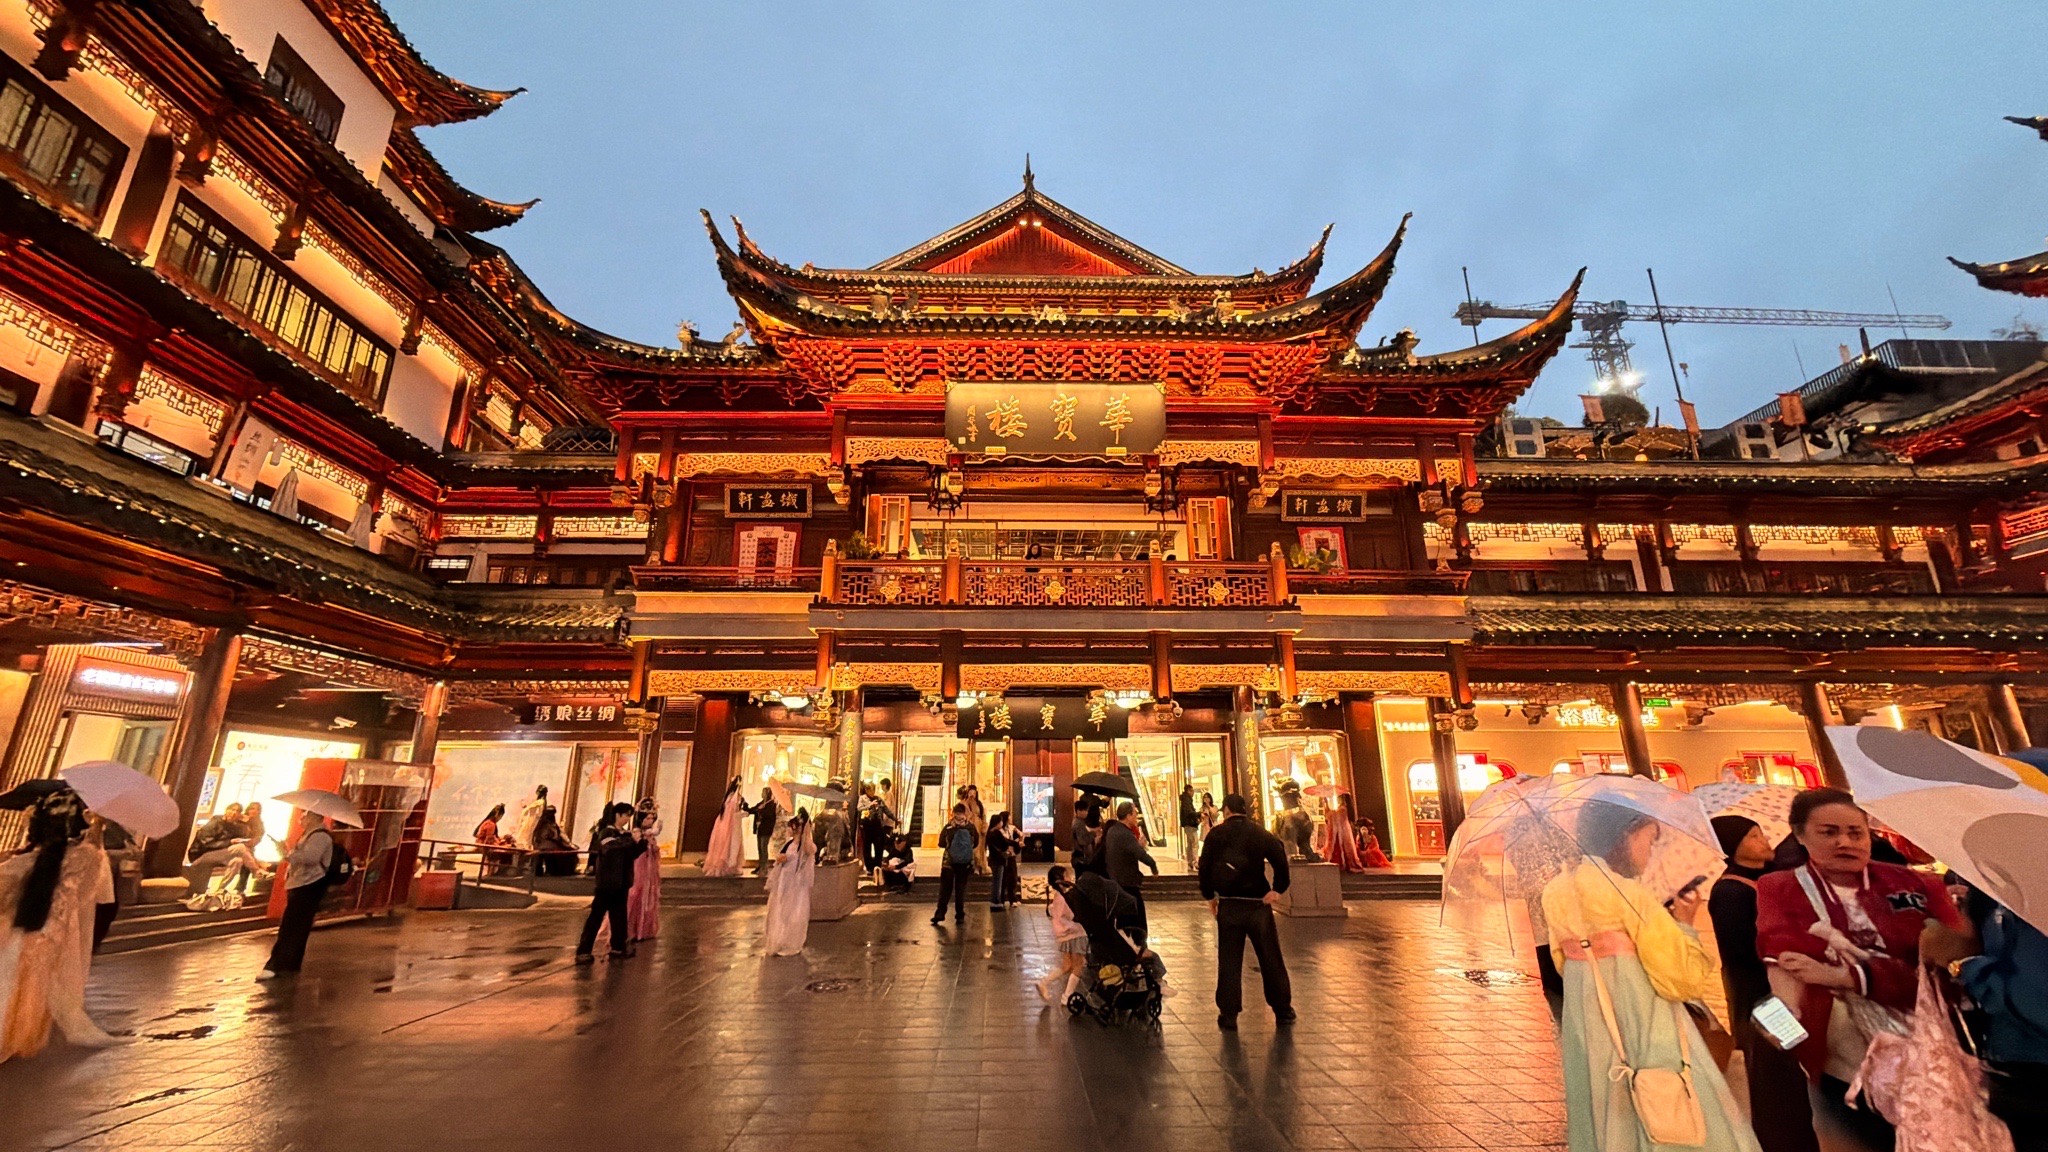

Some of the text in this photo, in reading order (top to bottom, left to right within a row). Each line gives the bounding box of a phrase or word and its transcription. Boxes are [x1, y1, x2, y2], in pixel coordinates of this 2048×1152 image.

[985, 393, 1133, 444] 華寶樓
[534, 705, 616, 721] 绣娘丝绸
